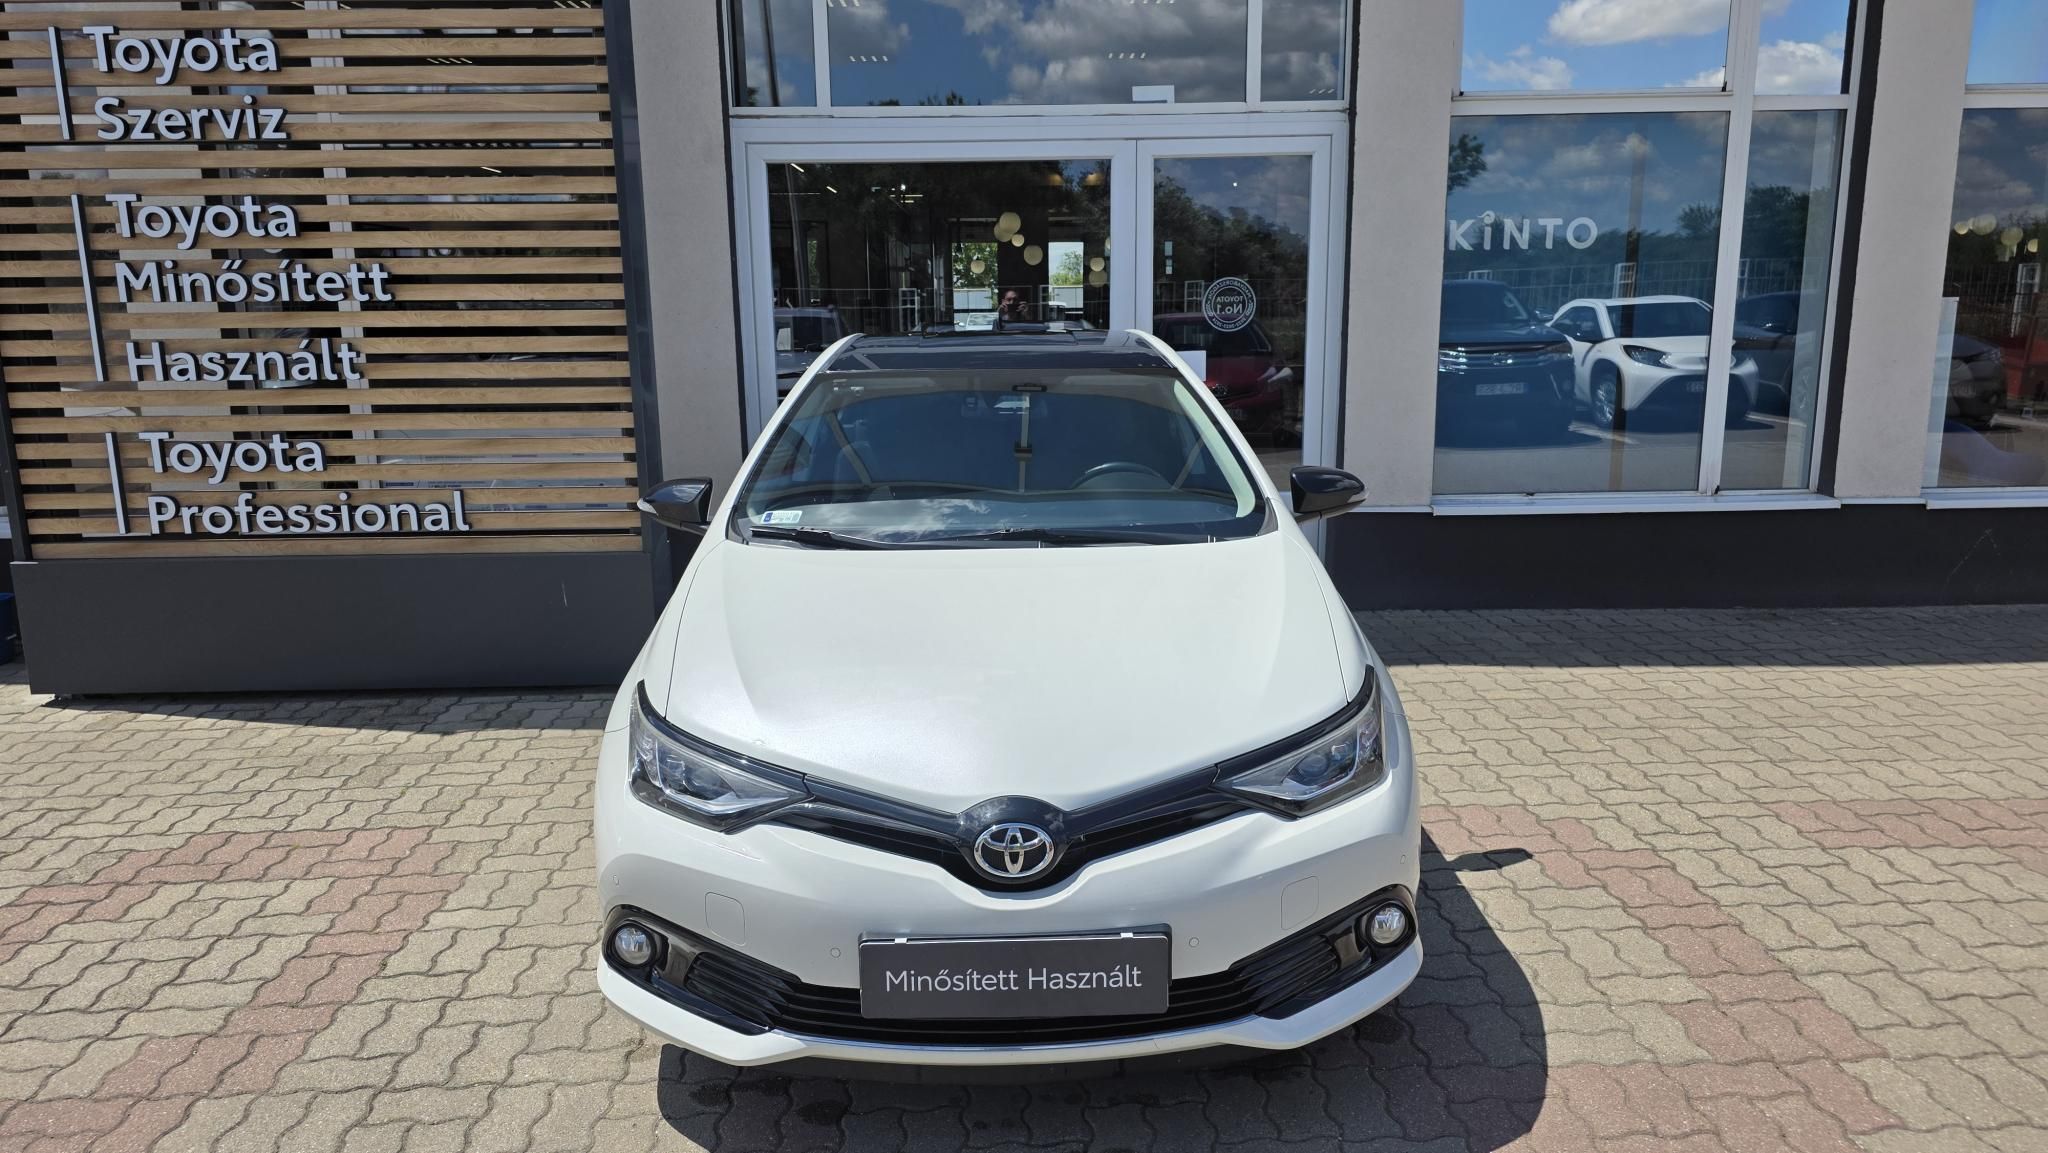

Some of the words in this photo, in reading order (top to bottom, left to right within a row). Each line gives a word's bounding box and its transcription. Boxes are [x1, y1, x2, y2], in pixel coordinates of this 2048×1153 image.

[83, 26, 278, 85] Toyota
[94, 95, 288, 140] Szerviz
[105, 194, 297, 249] Toyota
[115, 259, 392, 302] Minősített
[126, 338, 360, 381] Használt
[139, 432, 325, 485] Toyota
[147, 490, 470, 534] Professional
[885, 968, 1019, 992] Minősített
[1028, 964, 1142, 990] Használt
